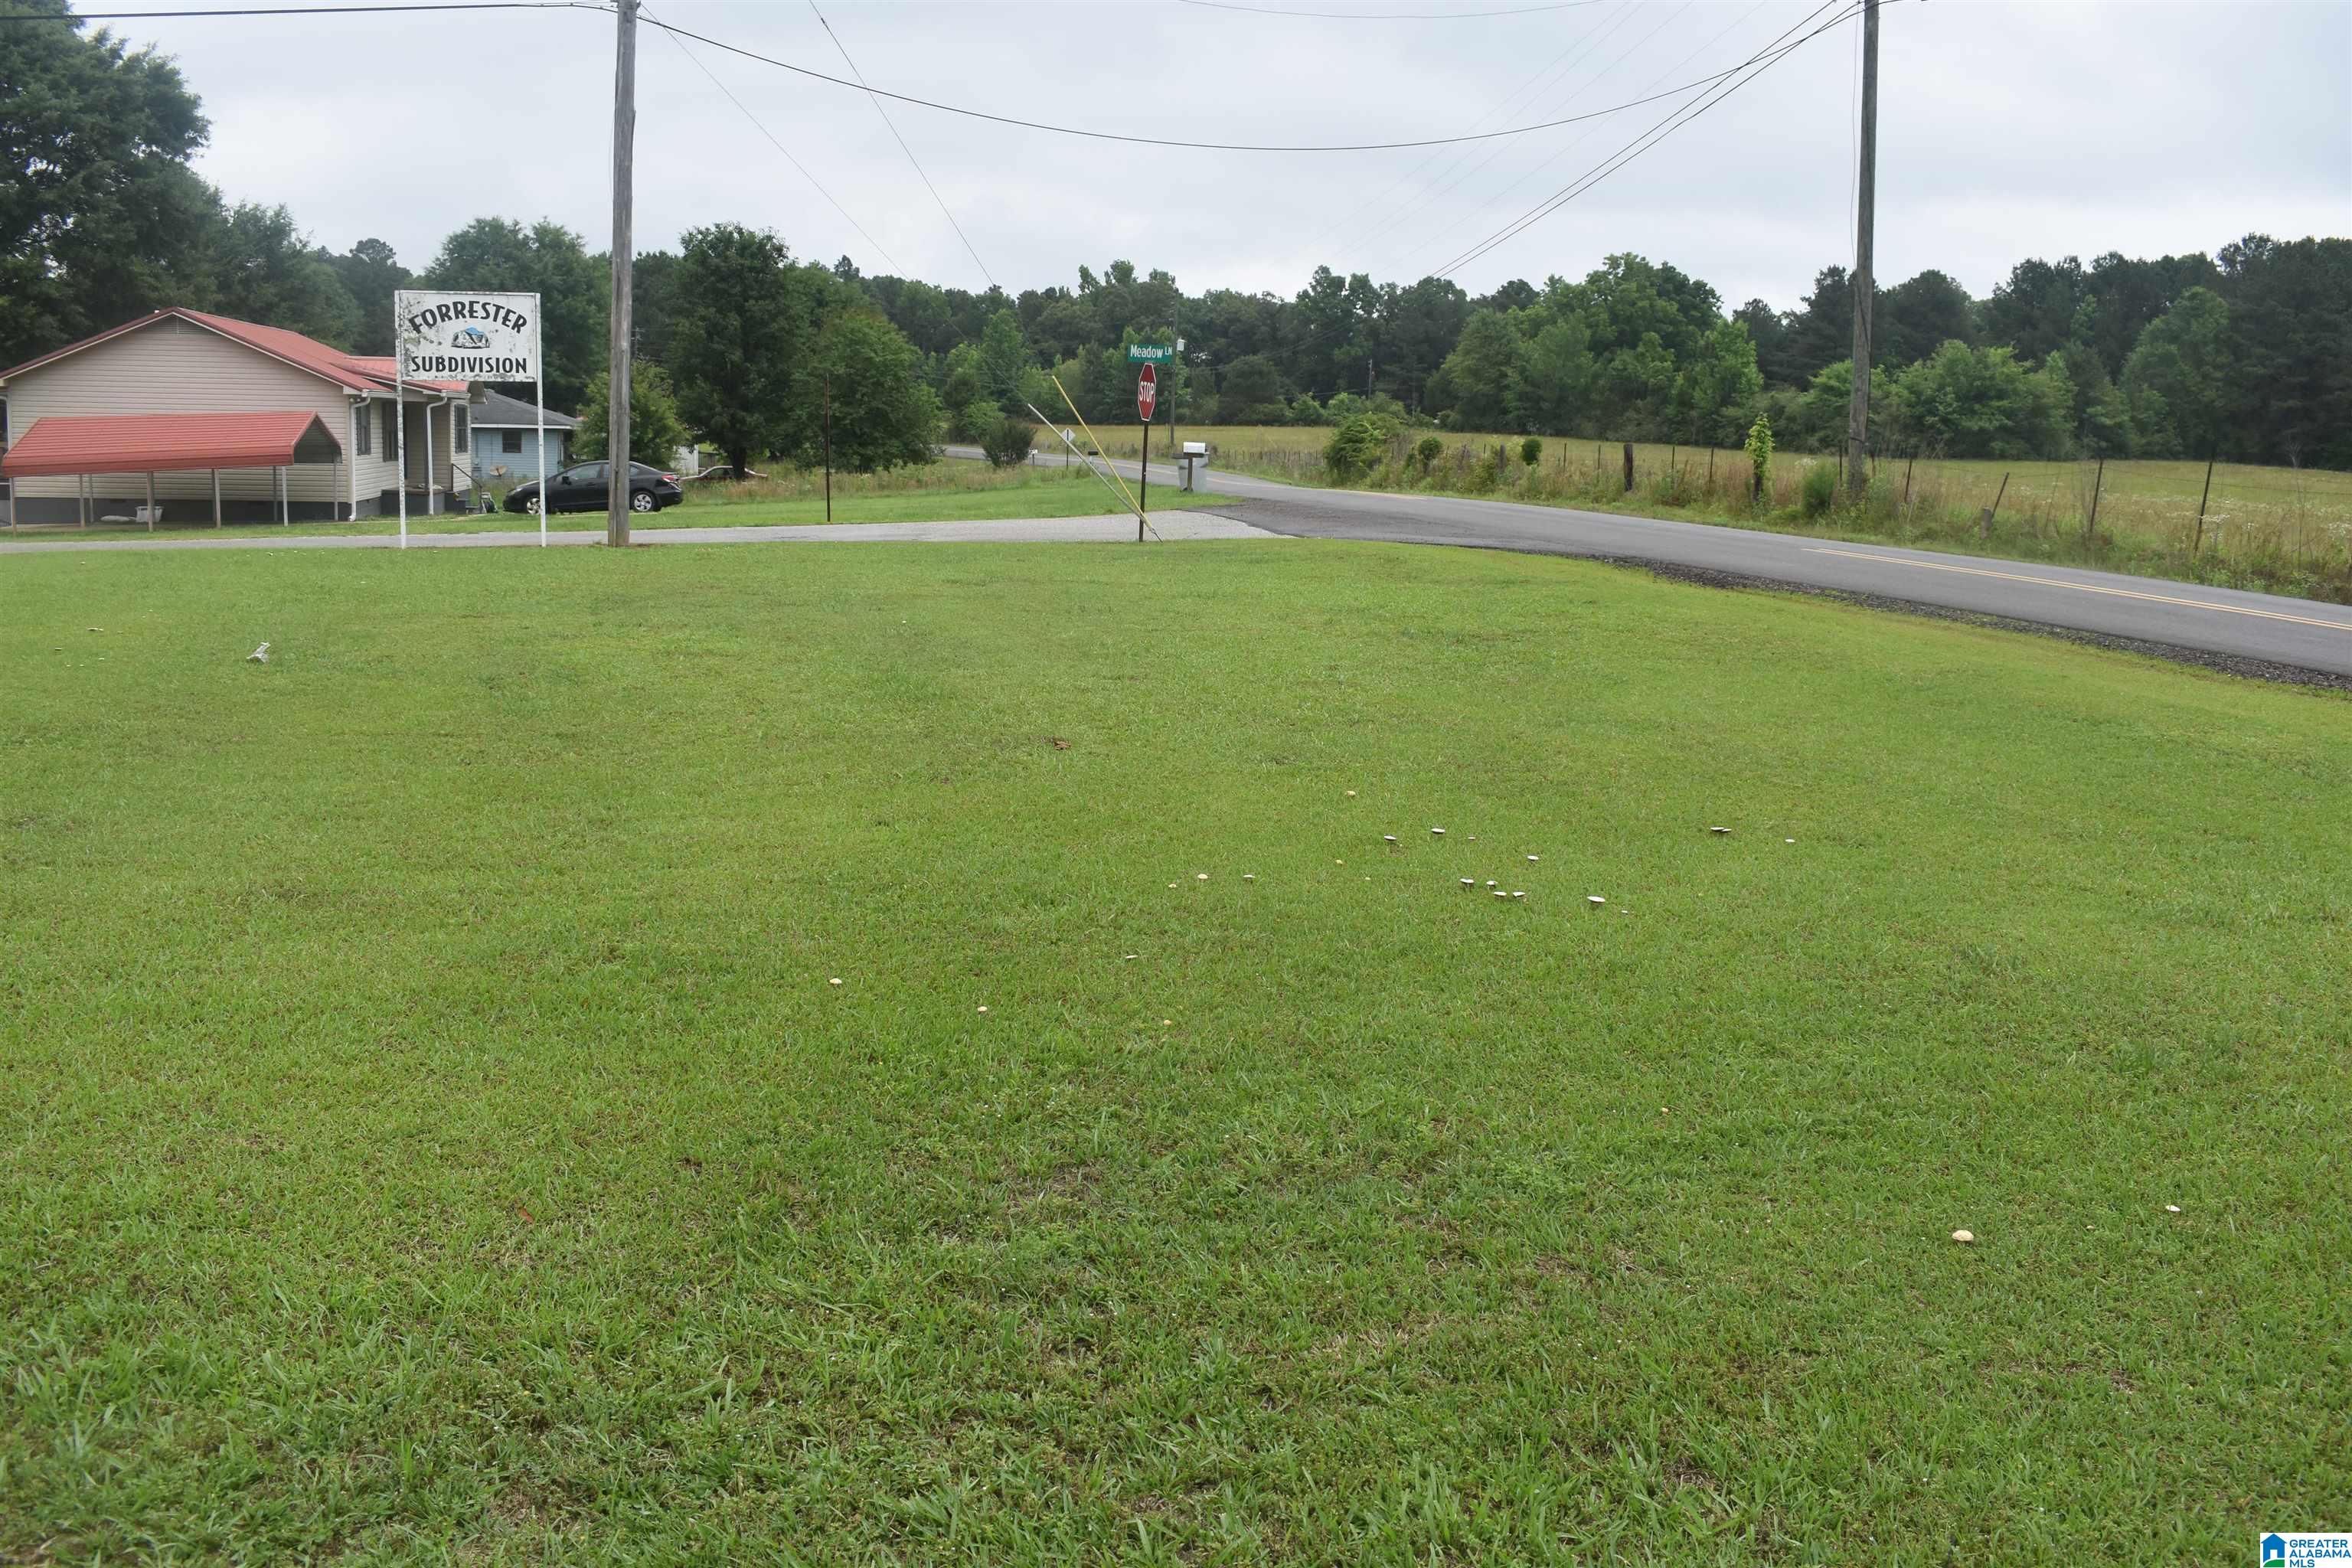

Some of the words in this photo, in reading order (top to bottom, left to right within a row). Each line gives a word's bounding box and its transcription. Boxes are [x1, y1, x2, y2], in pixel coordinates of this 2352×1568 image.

[409, 301, 527, 334] FORRESTER
[1130, 345, 1163, 358] Meadow
[411, 355, 527, 373] SUBDIVISION
[1139, 381, 1155, 403] STOP
